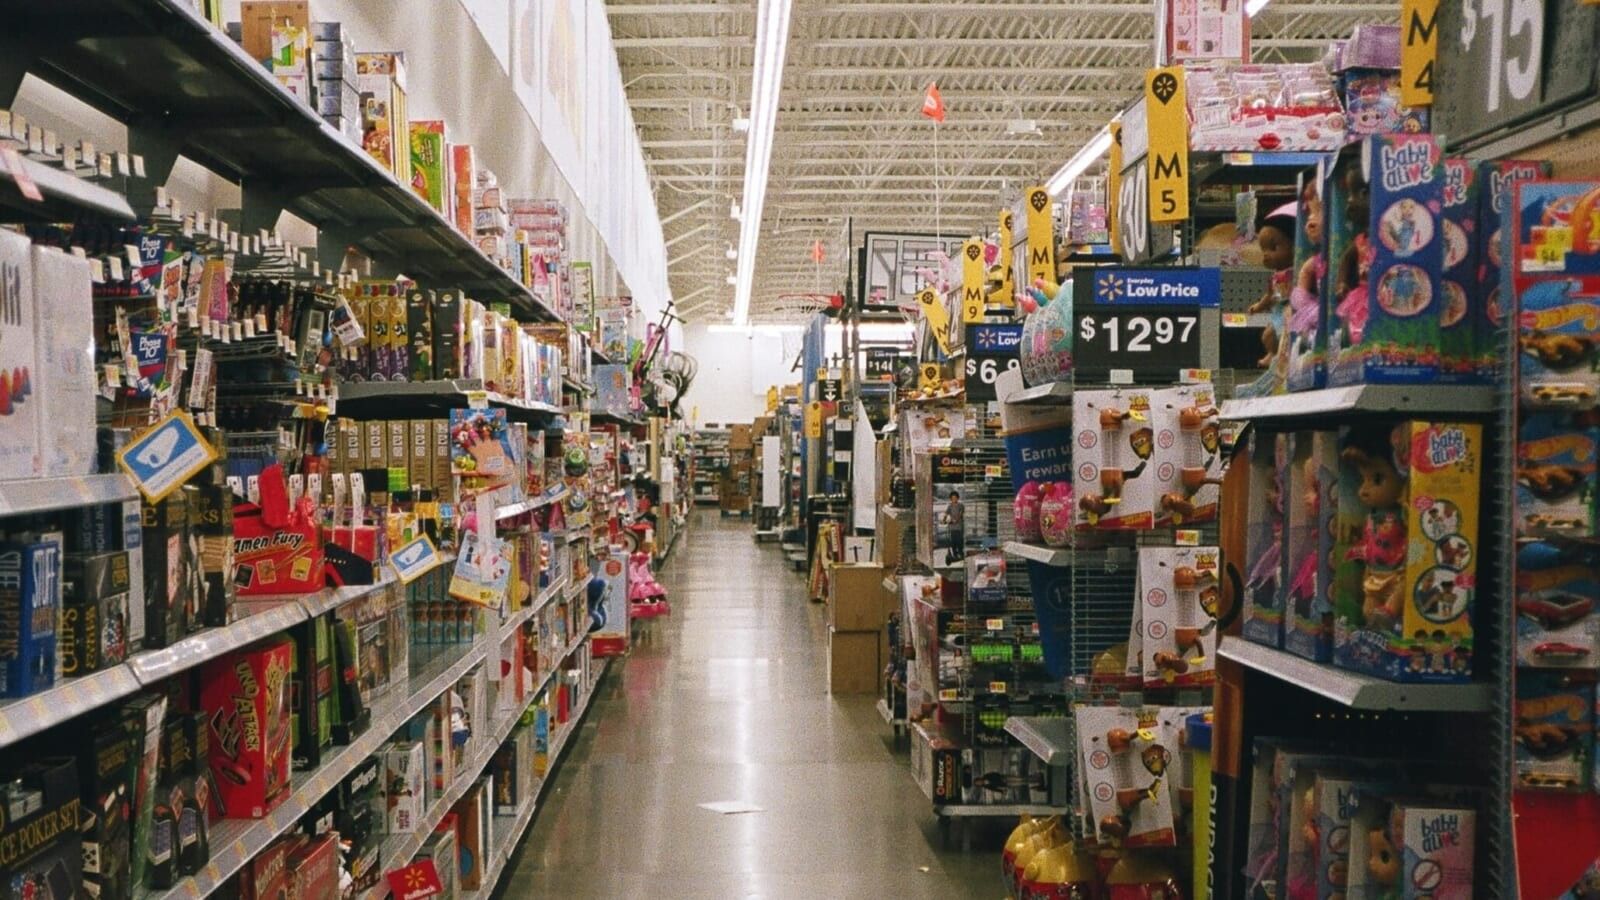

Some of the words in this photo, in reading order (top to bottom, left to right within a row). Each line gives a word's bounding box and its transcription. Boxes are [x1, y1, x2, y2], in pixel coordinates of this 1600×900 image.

[1154, 151, 1182, 180] M
[1382, 142, 1428, 173] baby
[1162, 190, 1177, 214] 5
[140, 236, 162, 252] Phase
[145, 246, 157, 259] 10
[1032, 247, 1050, 266] M
[1127, 277, 1154, 286] Everyday
[1127, 284, 1160, 297] Low
[1161, 283, 1199, 297] Price
[966, 287, 981, 301] M
[969, 305, 978, 319] 9
[139, 335, 162, 351] Phase
[998, 334, 1020, 346] Low
[144, 346, 157, 358] 10
[1431, 430, 1463, 450] baby
[1021, 445, 1056, 462] Earn
[1060, 444, 1074, 456] u
[234, 533, 268, 554] amen
[274, 530, 304, 551] Fury
[62, 607, 78, 673] CHIPS
[235, 661, 260, 697] UNO
[20, 810, 59, 855] POKER
[60, 797, 82, 832] SET
[1421, 814, 1458, 838] baby
